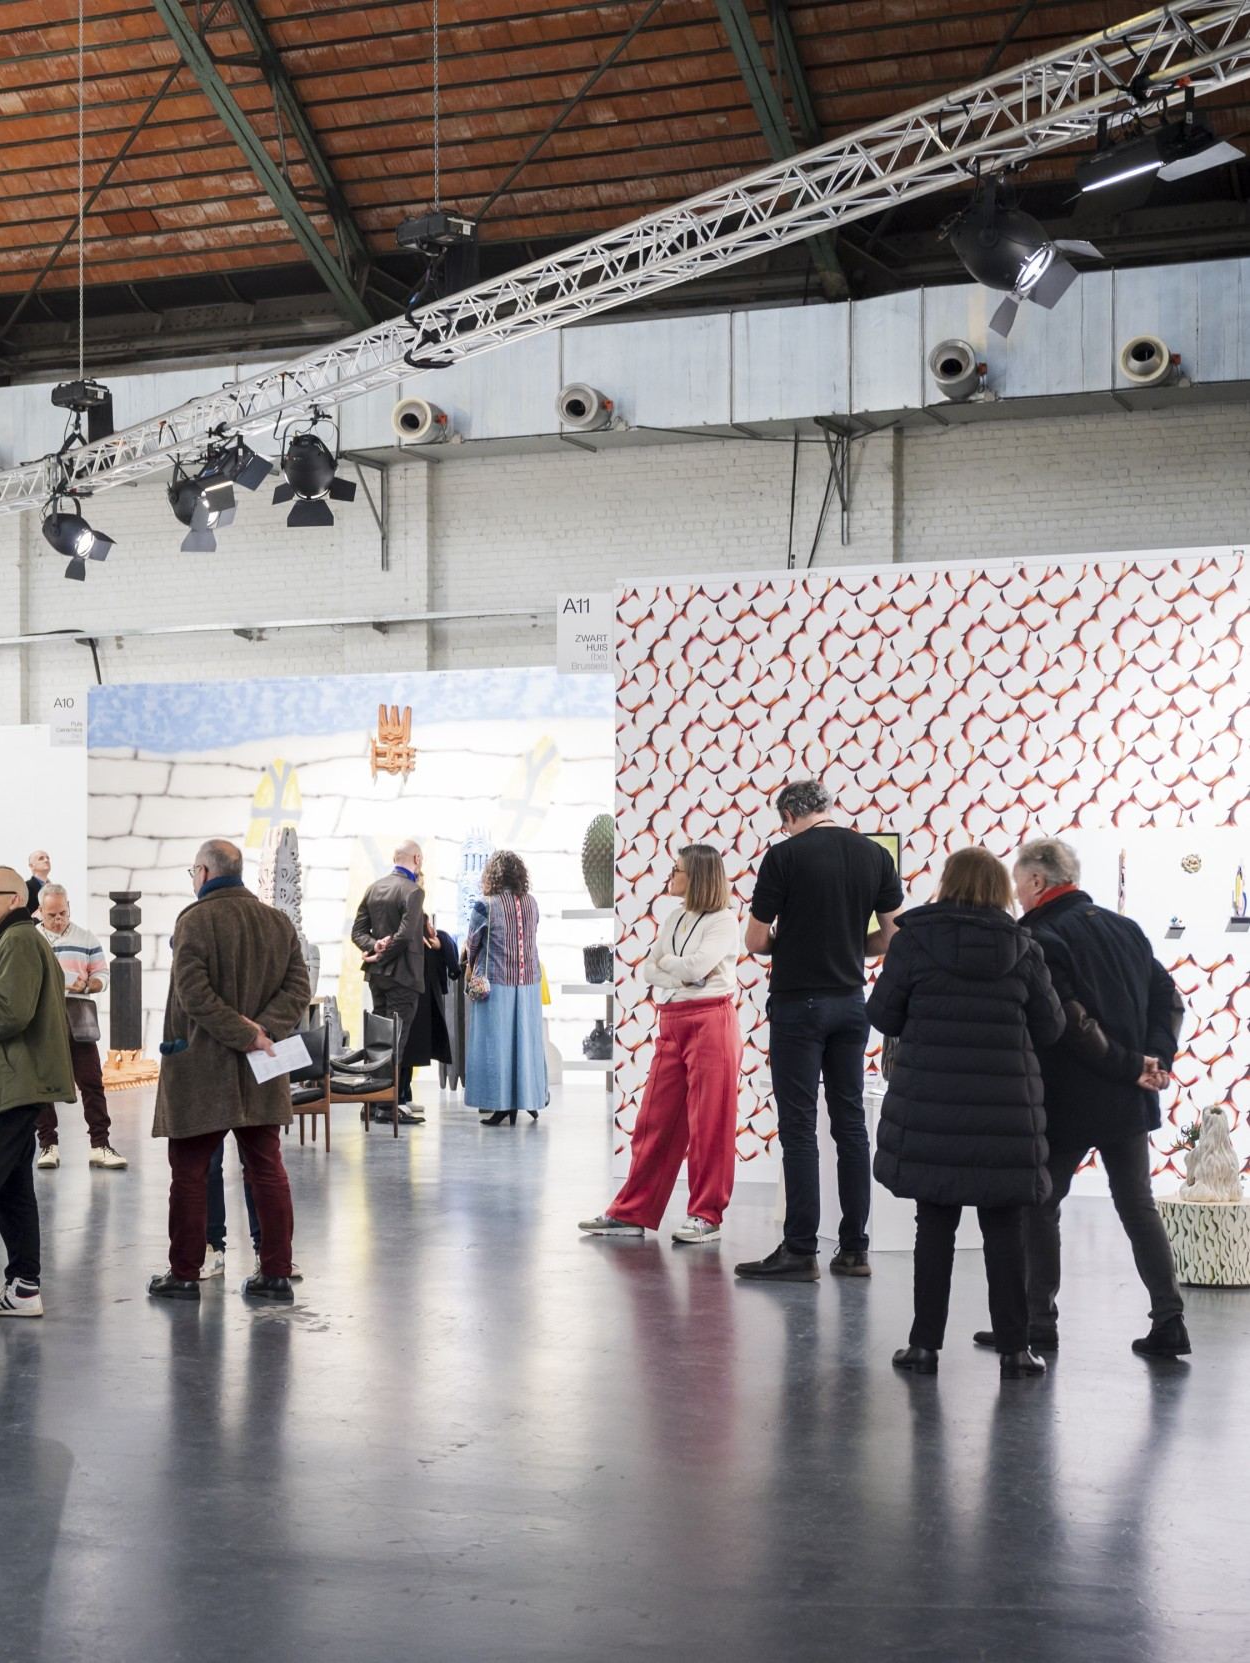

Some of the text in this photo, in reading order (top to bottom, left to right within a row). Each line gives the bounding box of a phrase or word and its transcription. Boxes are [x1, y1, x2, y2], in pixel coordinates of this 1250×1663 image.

[562, 597, 590, 614] A11
[574, 633, 608, 643] ZWART
[586, 643, 608, 652] HUIS
[53, 697, 75, 709] A10
